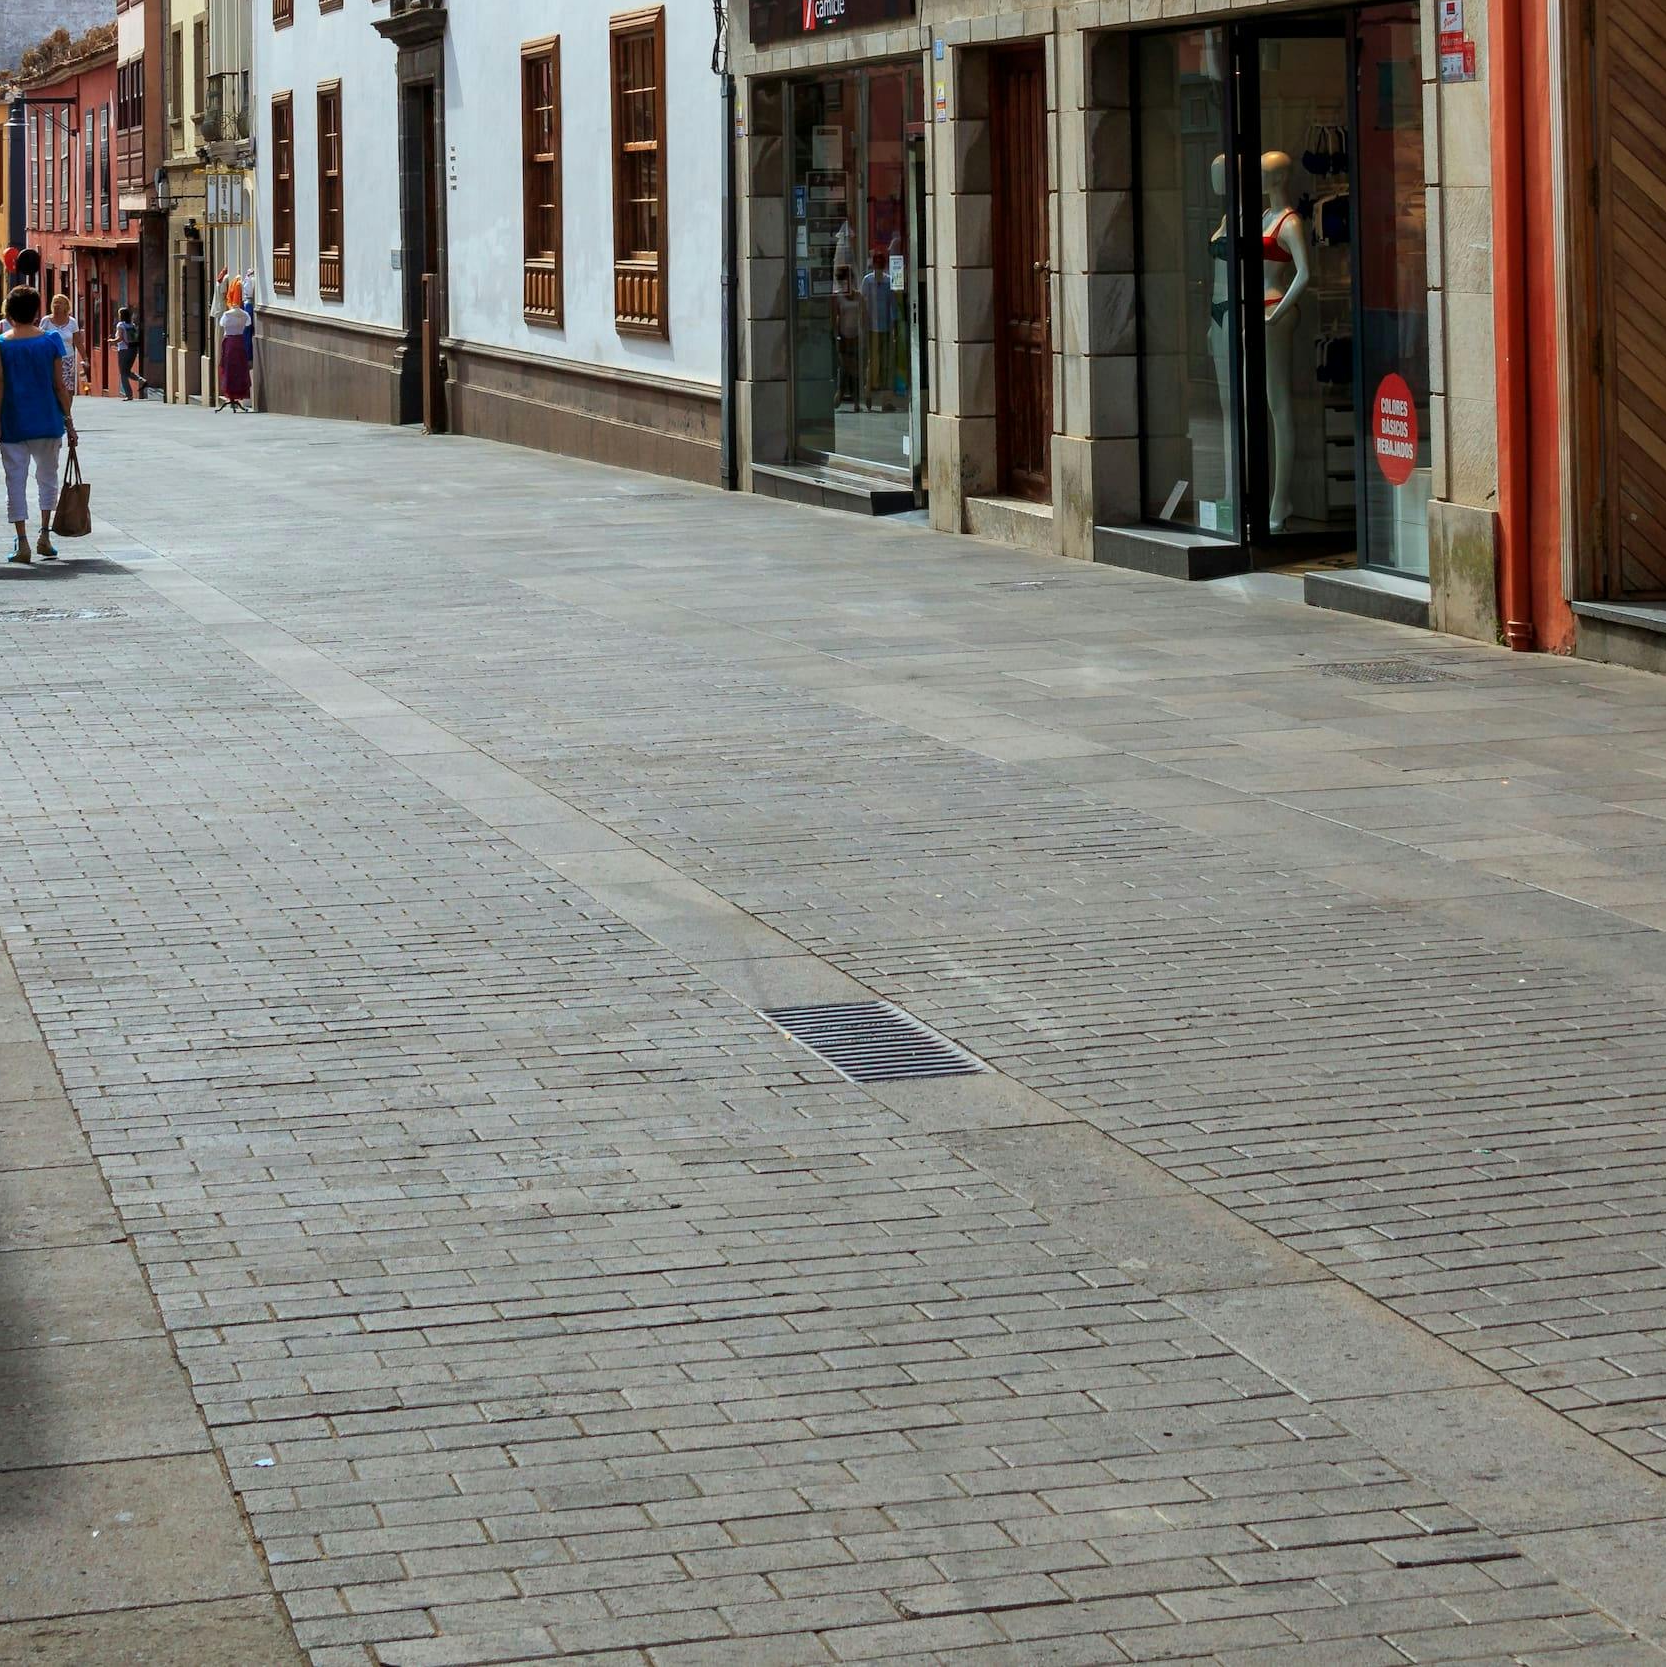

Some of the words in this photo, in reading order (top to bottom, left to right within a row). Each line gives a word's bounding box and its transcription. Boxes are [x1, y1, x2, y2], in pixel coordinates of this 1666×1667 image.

[1440, 34, 1463, 47] Alarma
[1381, 398, 1408, 417] COLORES
[1381, 416, 1408, 437] BÁSICOS
[1377, 438, 1413, 459] REBAJADOS
